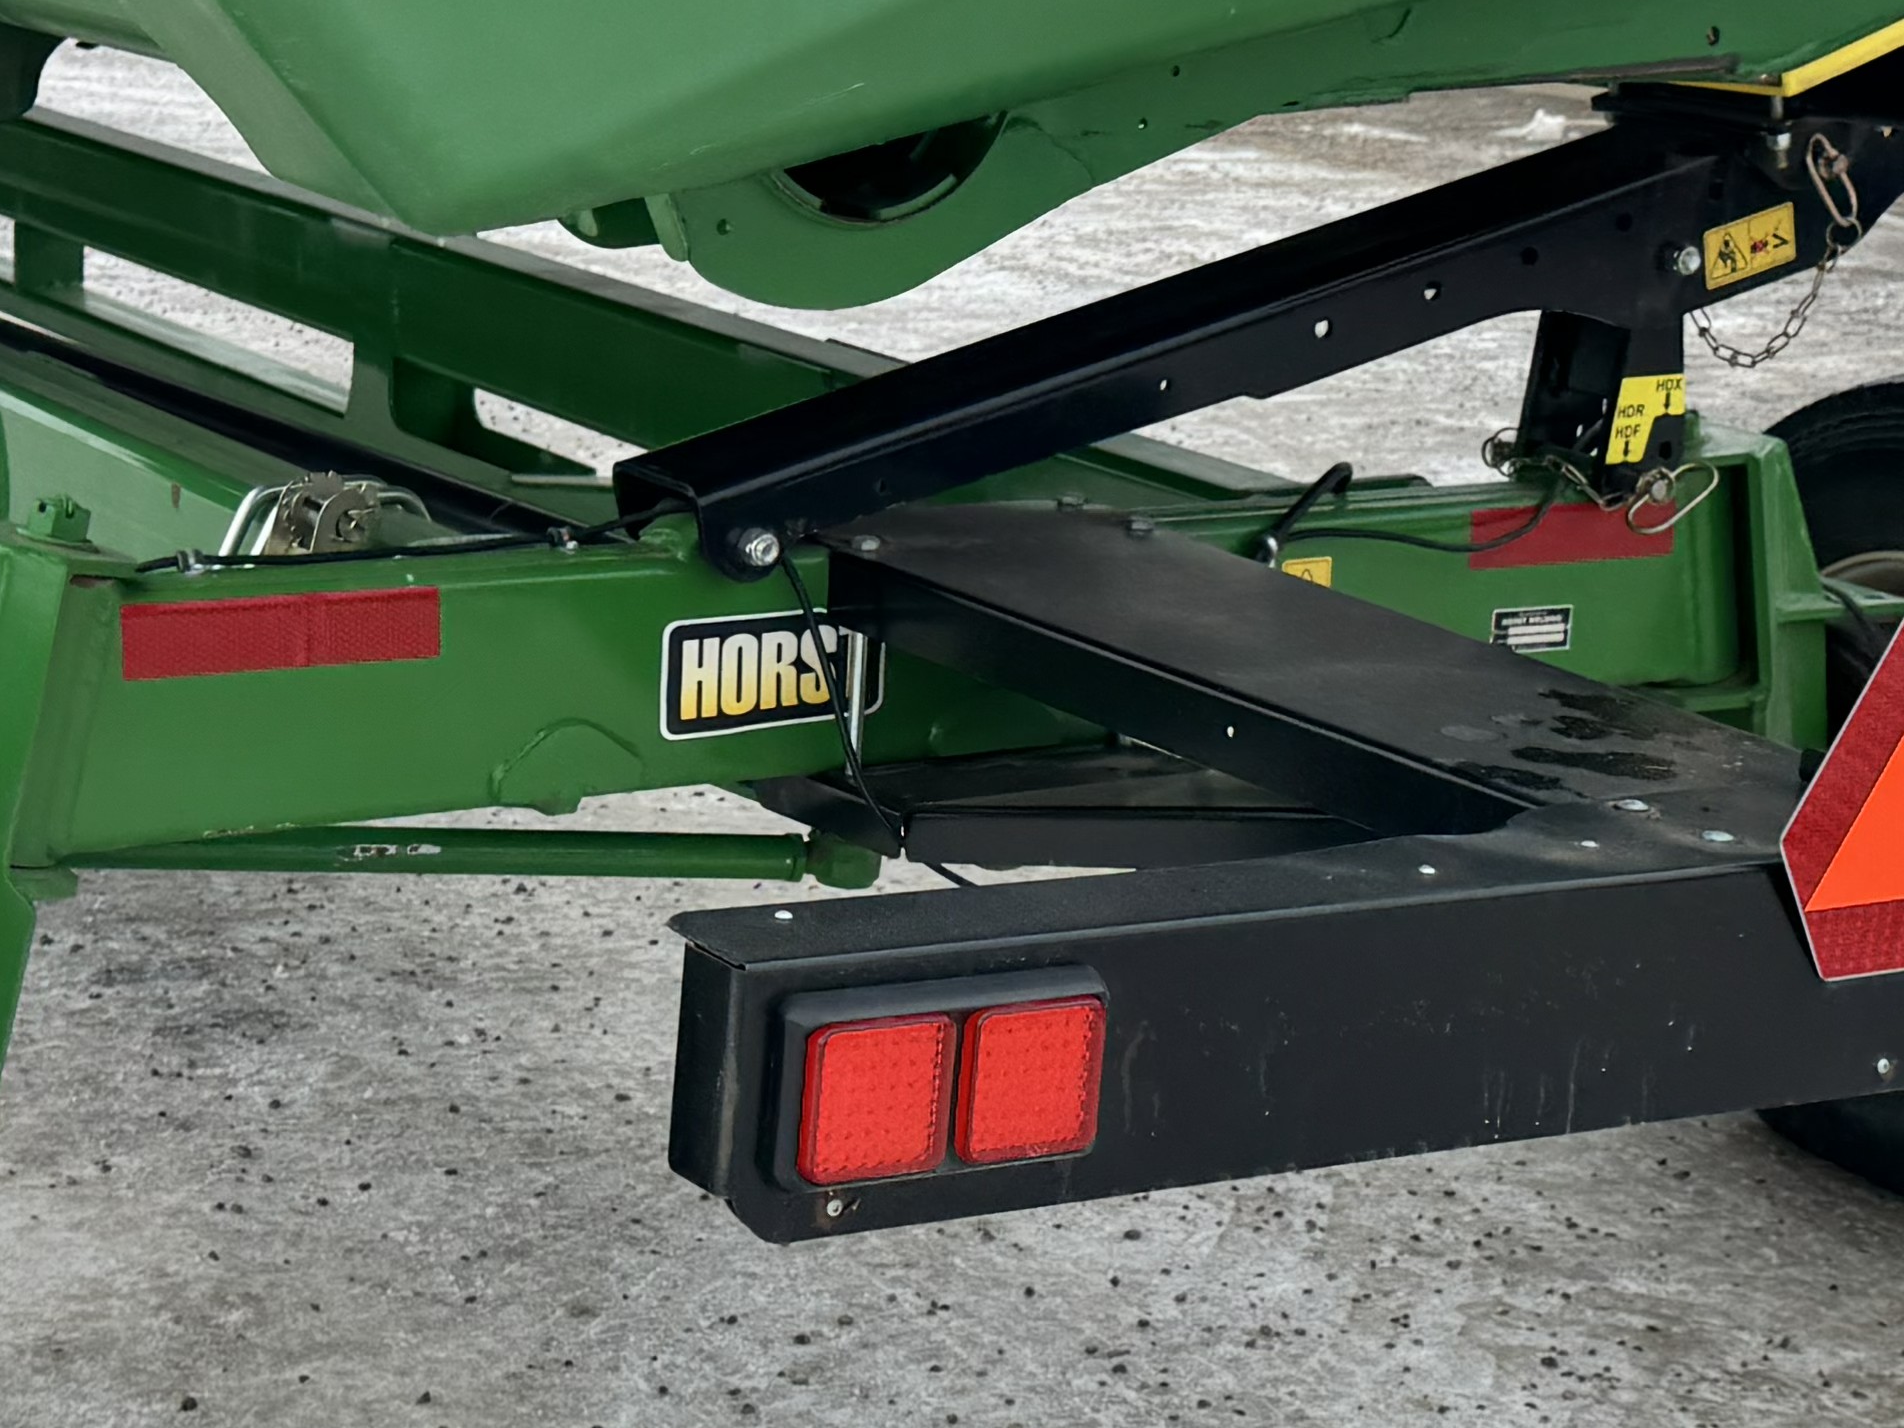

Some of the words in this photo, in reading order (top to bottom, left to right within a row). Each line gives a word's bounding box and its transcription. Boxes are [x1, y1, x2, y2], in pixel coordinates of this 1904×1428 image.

[1656, 378, 1683, 392] HDX
[1617, 404, 1645, 418] HDR
[1614, 424, 1641, 439] HDF
